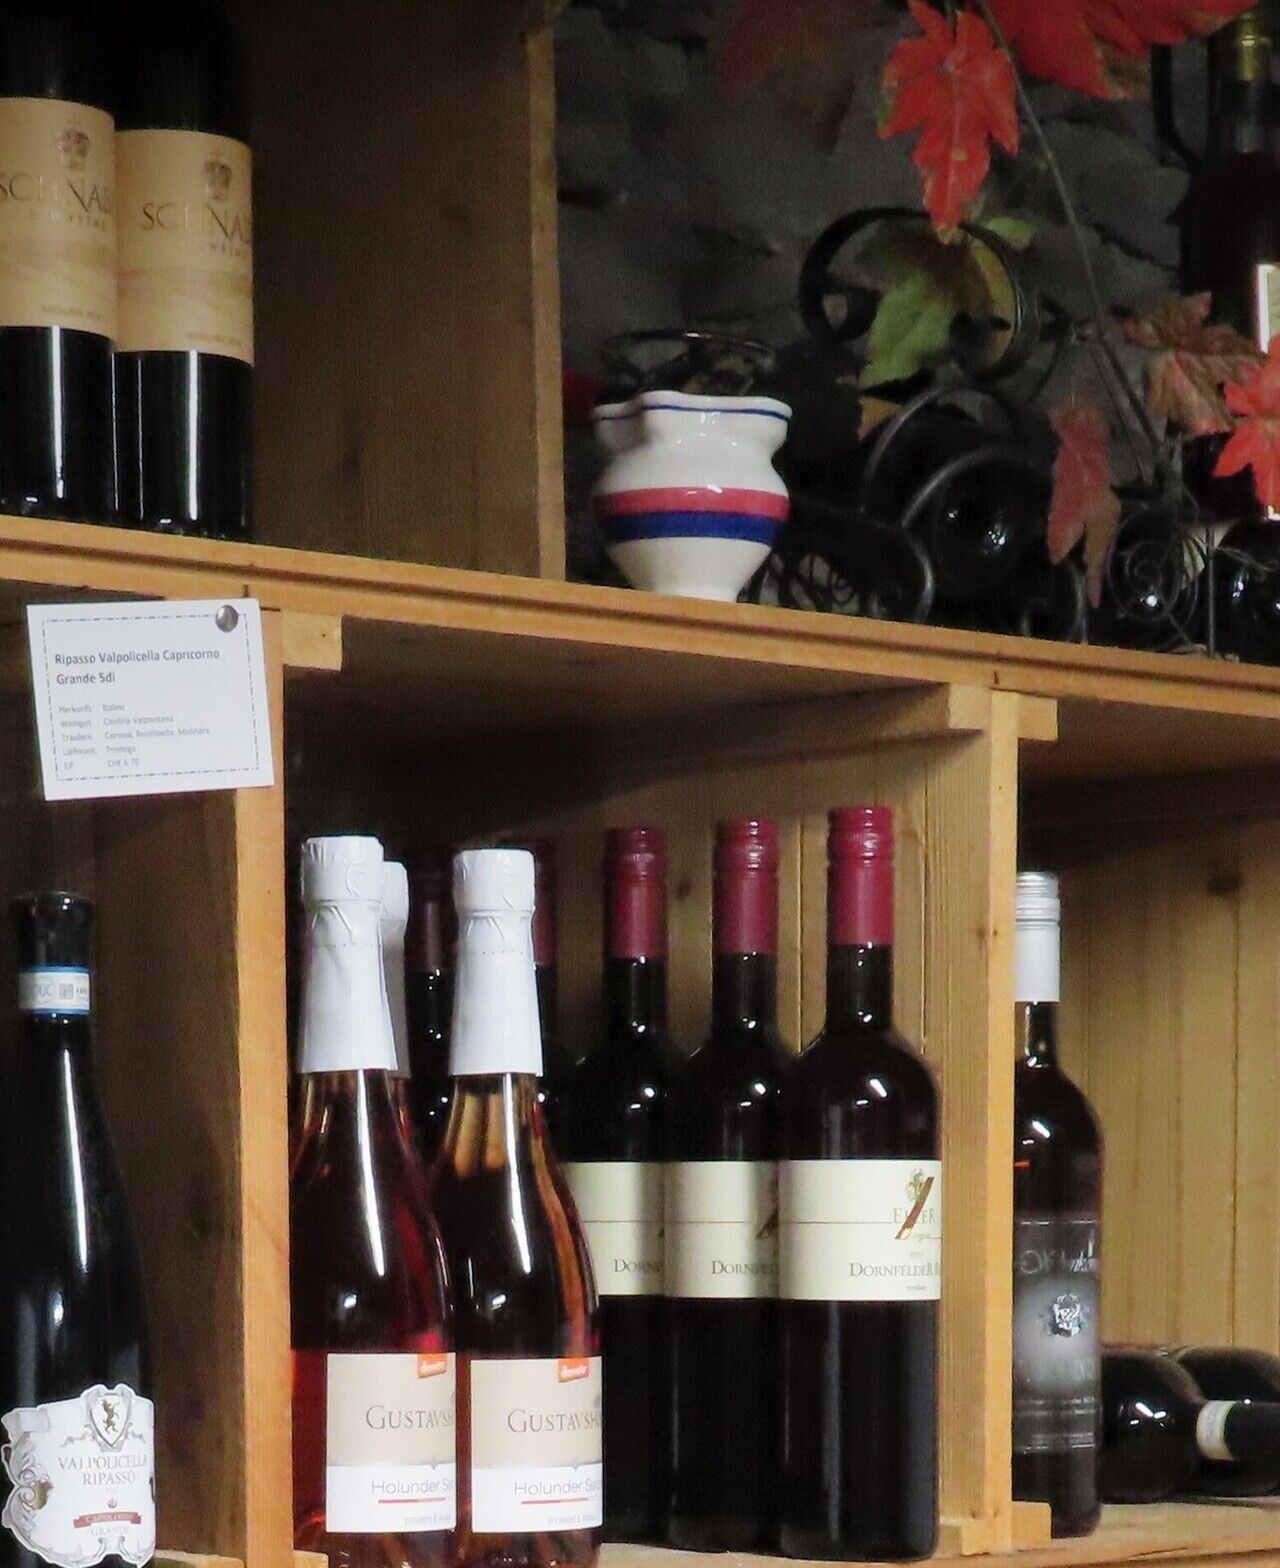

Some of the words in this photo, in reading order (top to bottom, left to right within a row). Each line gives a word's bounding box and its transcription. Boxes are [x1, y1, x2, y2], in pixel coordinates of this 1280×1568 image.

[54, 652, 96, 667] Ripasso
[99, 650, 160, 665] Valpolicella
[162, 649, 220, 663] Capricorno
[56, 673, 96, 685] Grande
[82, 1471, 136, 1485] RIPASSO
